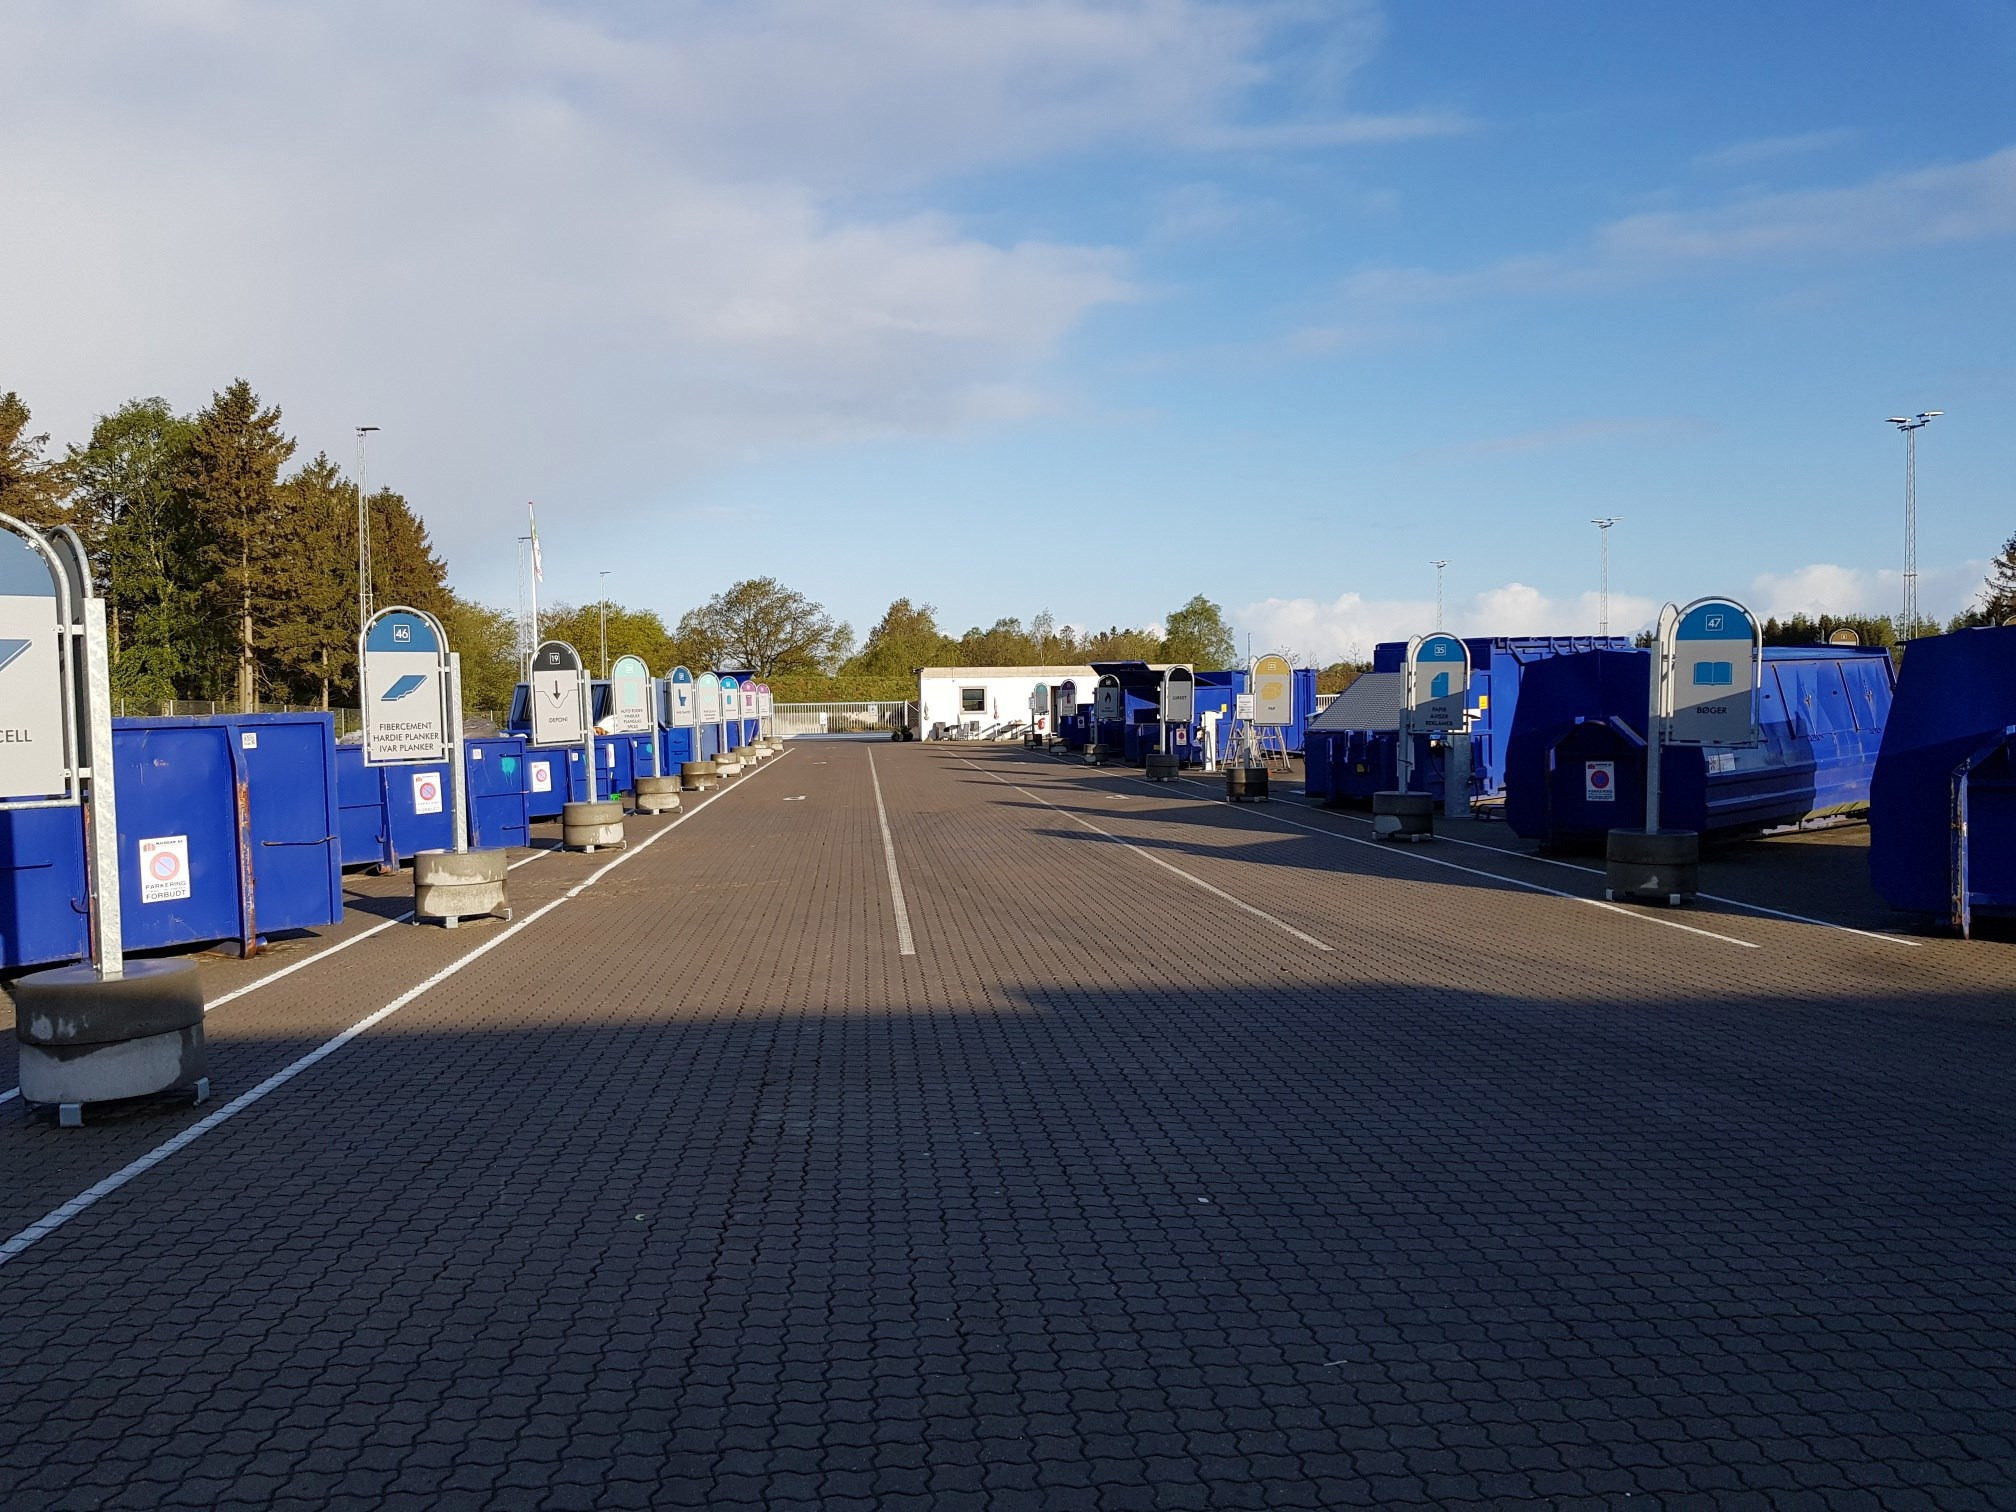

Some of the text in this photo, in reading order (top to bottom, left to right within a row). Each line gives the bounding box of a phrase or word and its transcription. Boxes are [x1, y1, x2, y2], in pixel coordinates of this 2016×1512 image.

[1708, 618, 1721, 628] 47
[396, 628, 409, 639] 46
[551, 654, 559, 662] 19
[1696, 706, 1727, 715] BØGER
[379, 722, 433, 731] FIBERCEMENT
[373, 732, 440, 742] HARDIE PLANKER
[379, 742, 434, 753] IVAR PLANKER
[145, 880, 187, 890] PARKERING
[146, 889, 186, 900] FORBUDT
